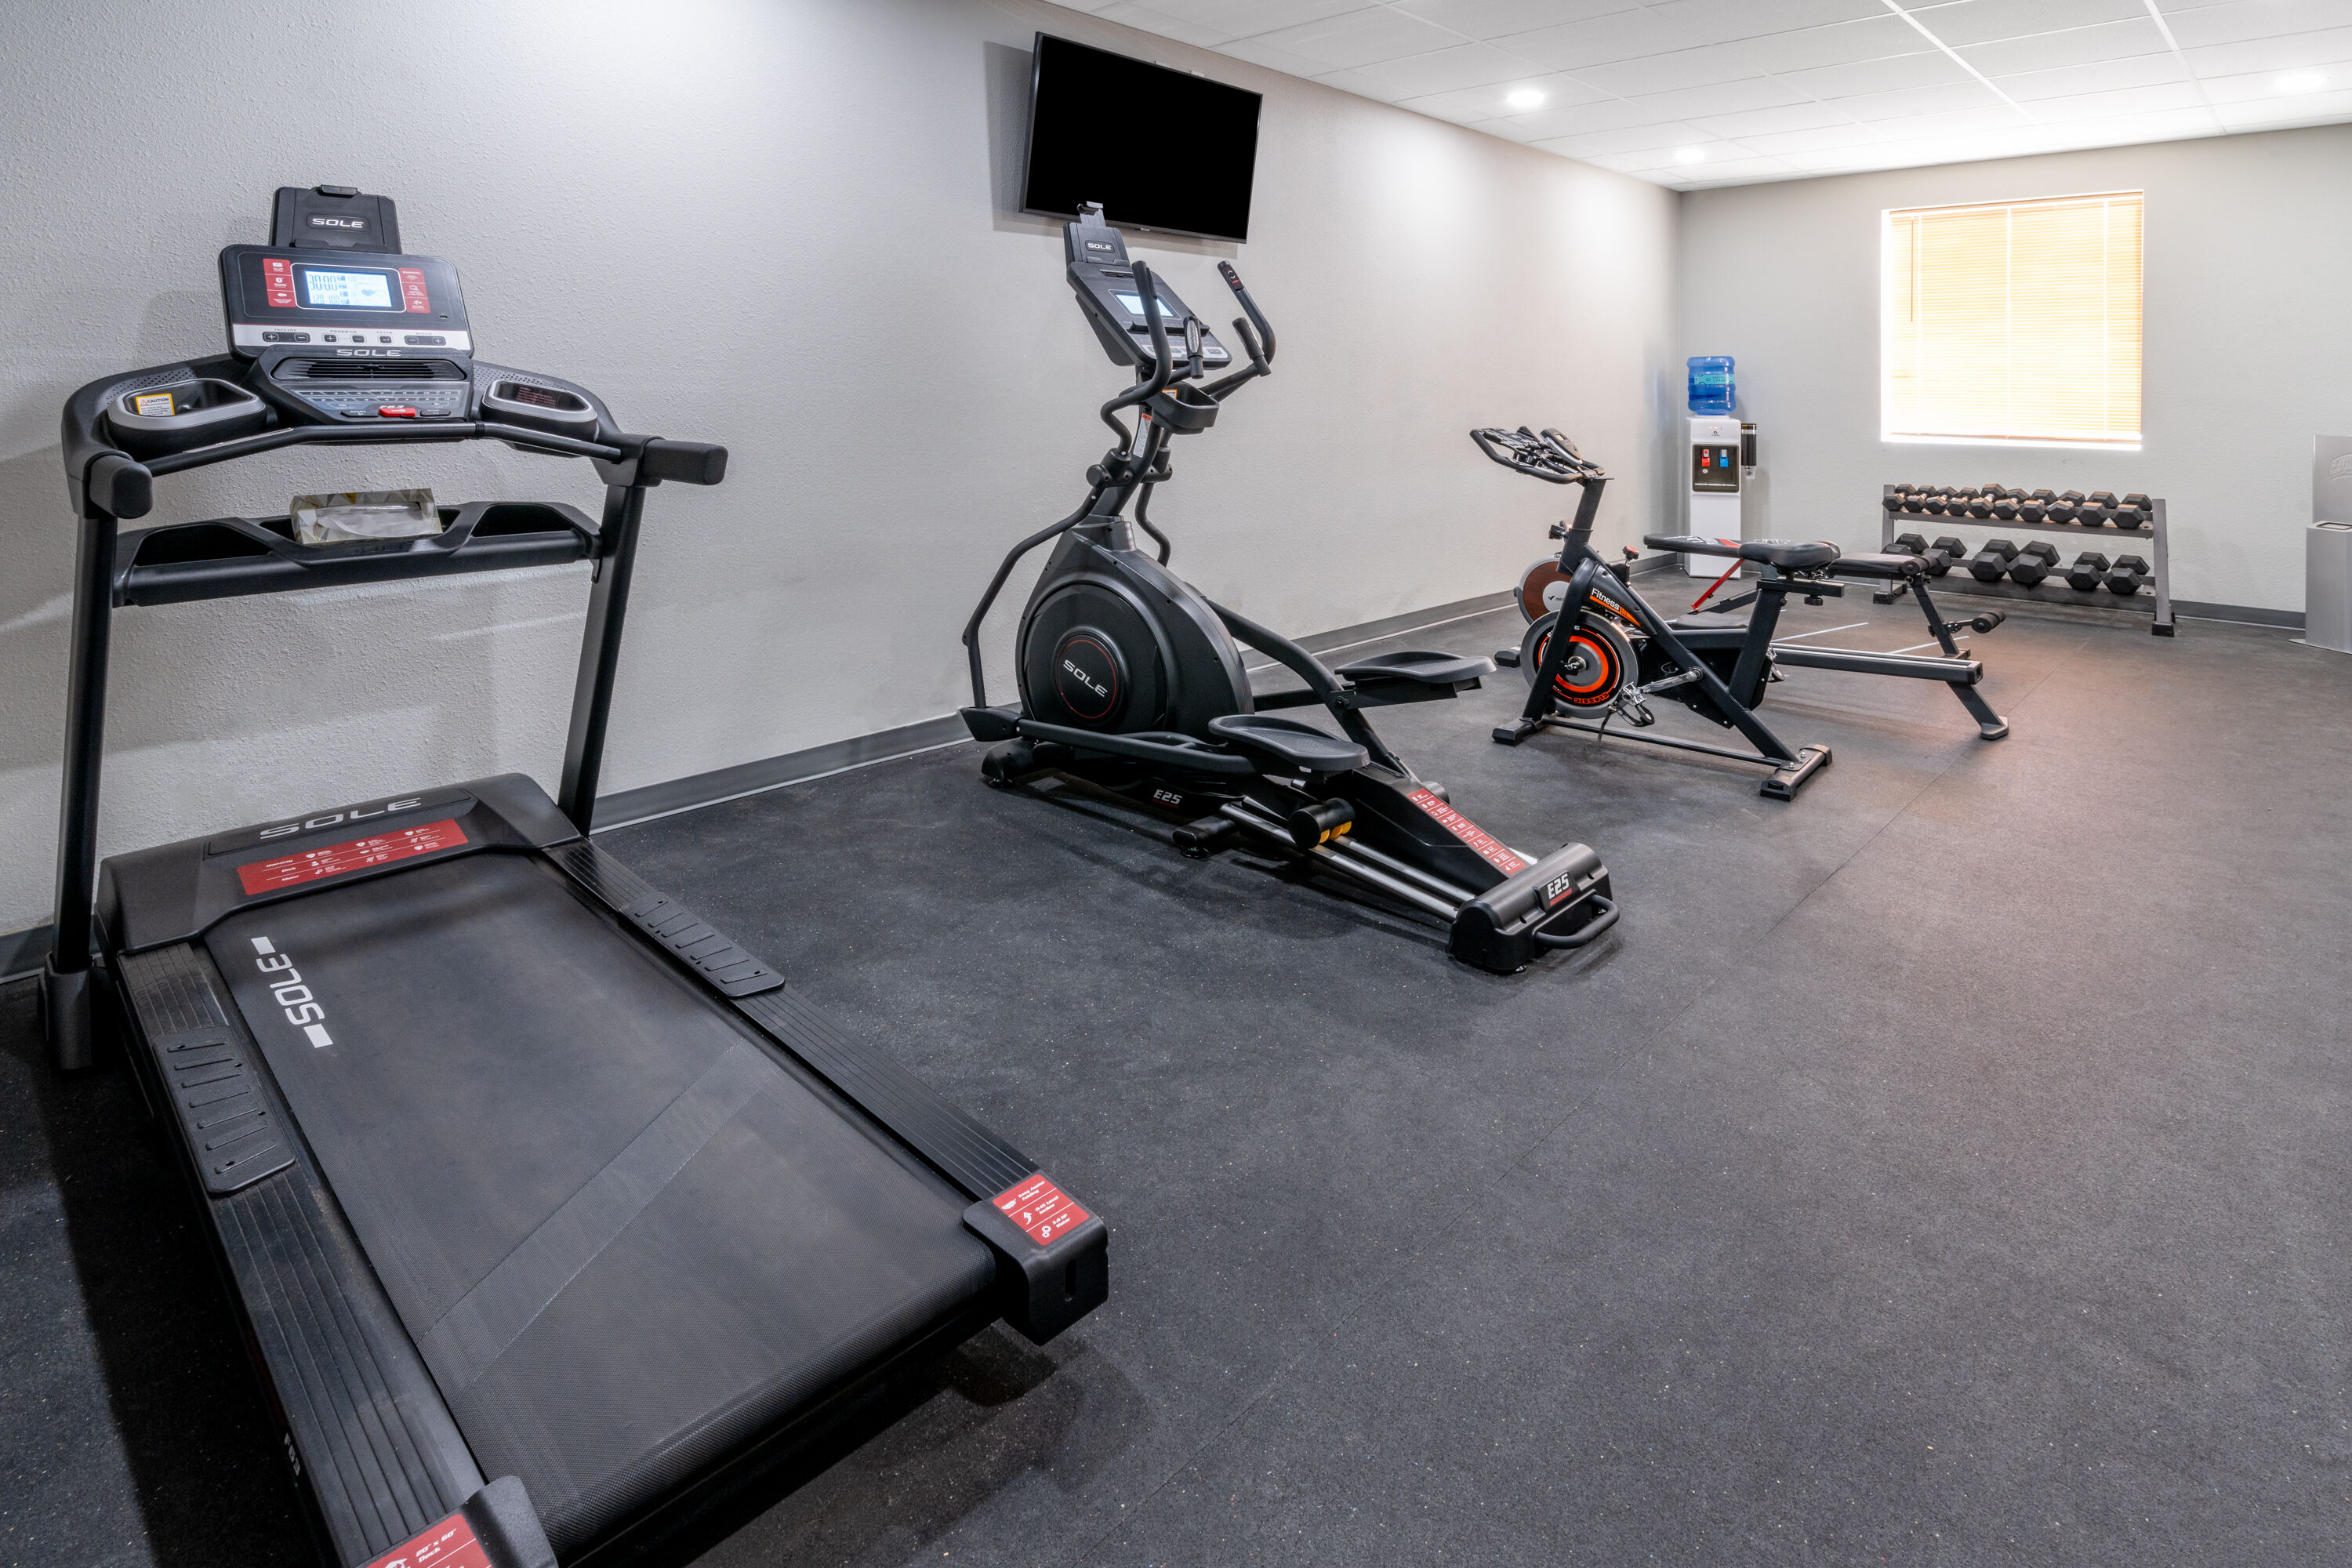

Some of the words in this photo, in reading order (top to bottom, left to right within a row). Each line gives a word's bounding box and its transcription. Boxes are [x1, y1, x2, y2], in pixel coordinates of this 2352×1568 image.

[312, 218, 364, 228] SOLE
[1592, 588, 1620, 611] Fitness
[1063, 659, 1108, 697] SOLE
[1574, 692, 1608, 703] CLASSIC
[1154, 789, 1182, 804] E25
[260, 797, 421, 840] SOLE
[1547, 873, 1570, 899] E25
[256, 953, 325, 1025] SOLE
[418, 1547, 441, 1563] Deck
